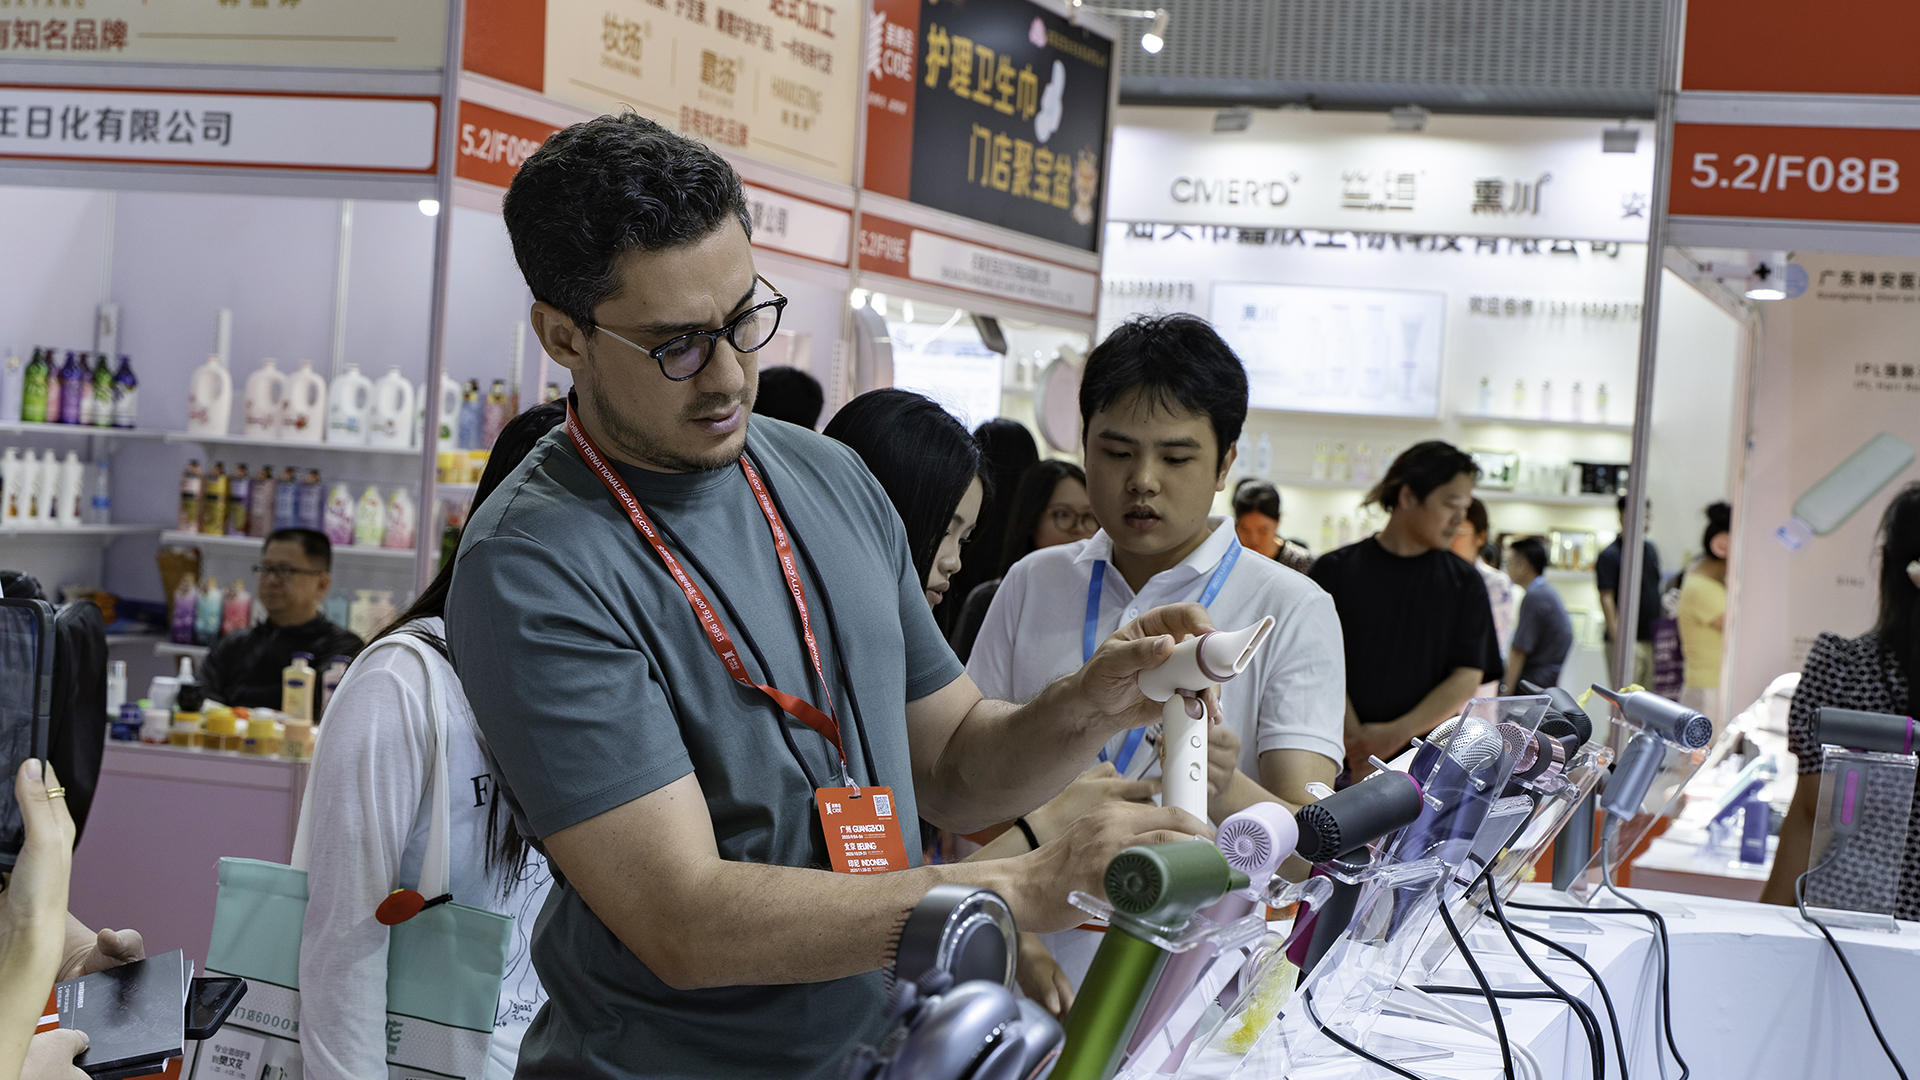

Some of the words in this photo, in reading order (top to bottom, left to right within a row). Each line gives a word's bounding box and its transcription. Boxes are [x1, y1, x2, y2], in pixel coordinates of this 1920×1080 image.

[925, 22, 1038, 121] 护理卫生巾
[967, 122, 1072, 210] 门店聚宝盆
[1691, 153, 1901, 195] 5.2/F08B
[1818, 269, 1920, 291] 广东神安医
[694, 597, 707, 610] 400
[702, 609, 715, 623] 931
[709, 623, 725, 643] 9933
[852, 824, 885, 833] GUANGZHOU
[856, 842, 877, 850] BEIJING
[861, 858, 889, 867] INDONESIA
